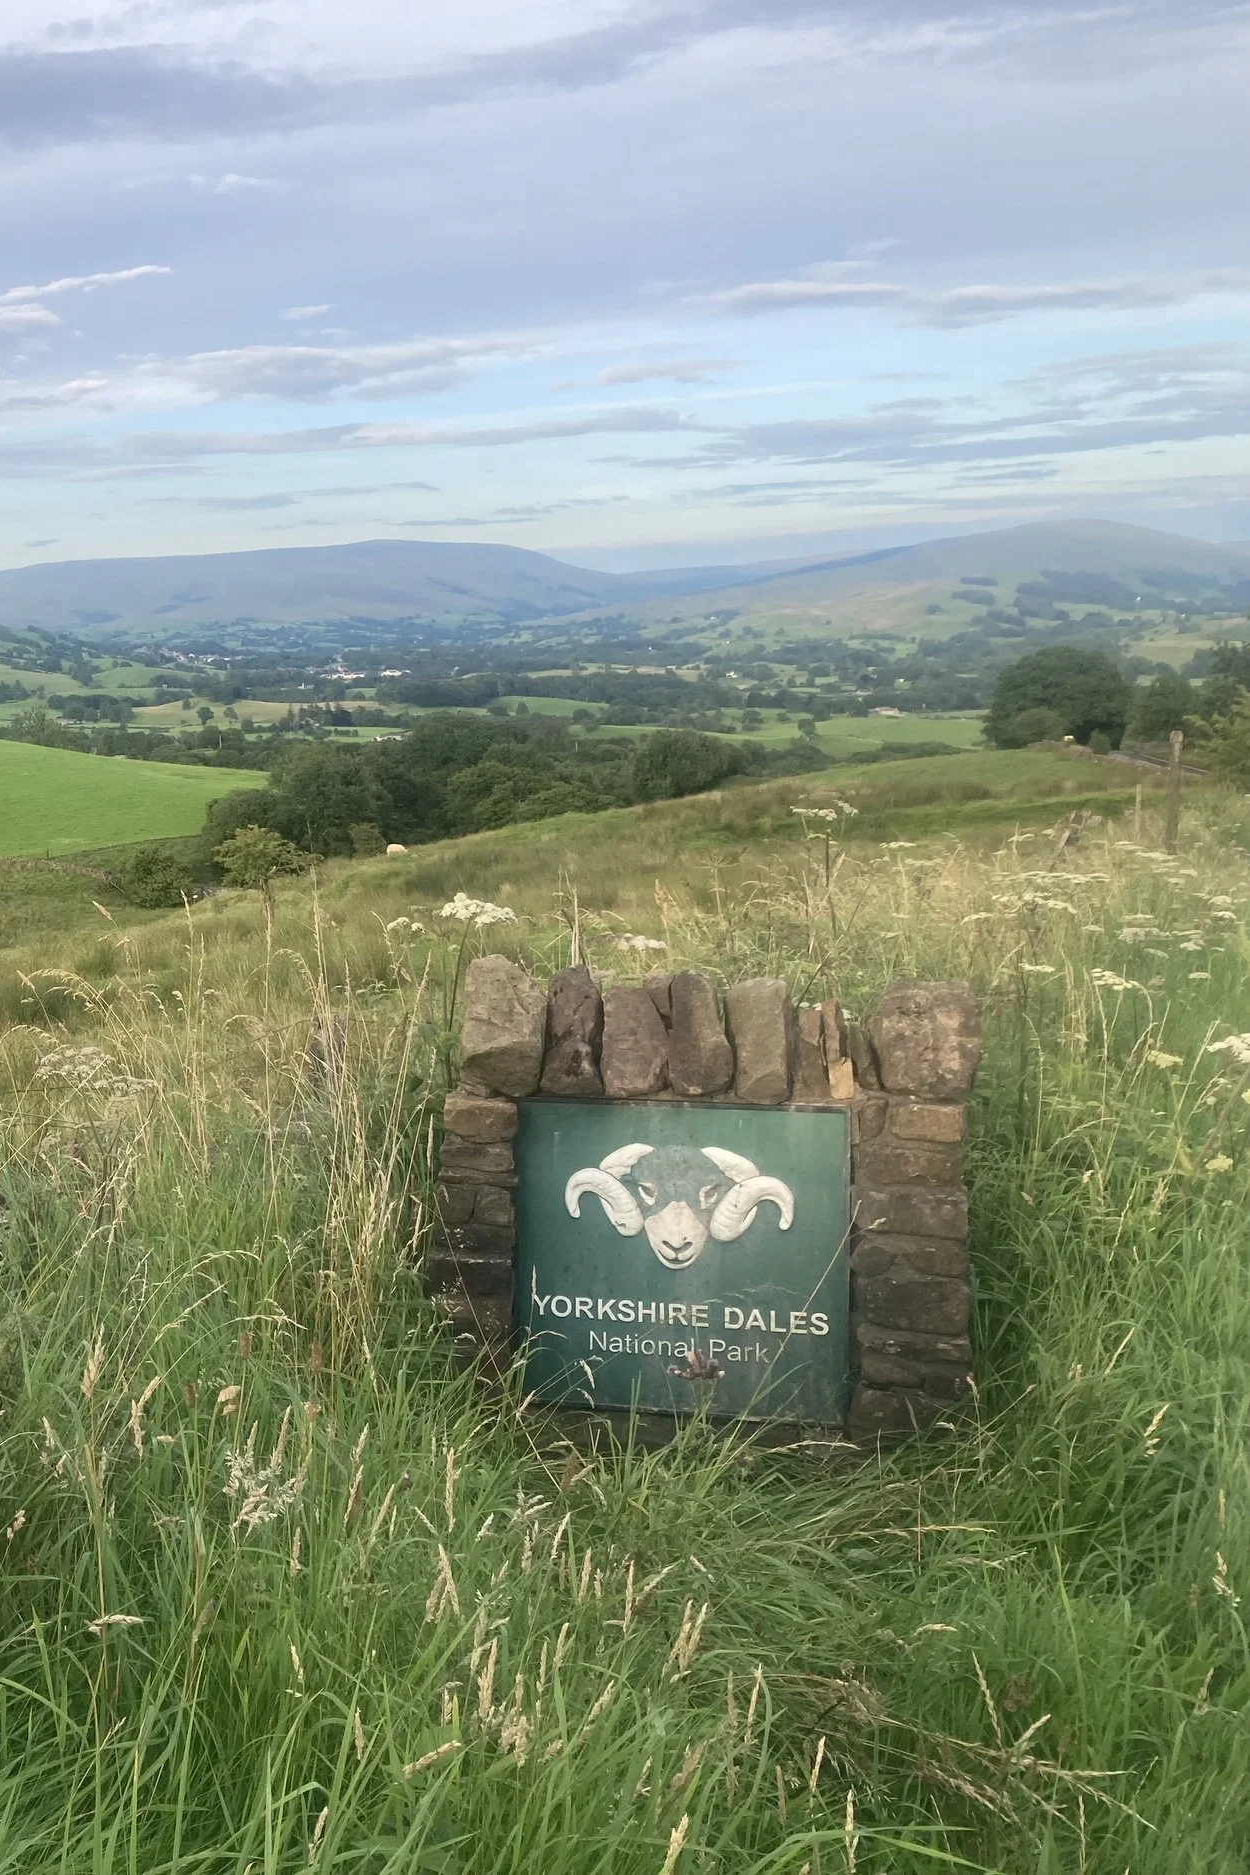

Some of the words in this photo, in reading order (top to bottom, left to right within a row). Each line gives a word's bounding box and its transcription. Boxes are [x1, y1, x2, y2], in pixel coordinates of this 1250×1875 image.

[533, 1294, 710, 1328] YORKSHIRE
[724, 1306, 830, 1336] DALES
[589, 1330, 695, 1358] National
[709, 1339, 771, 1364] Park
